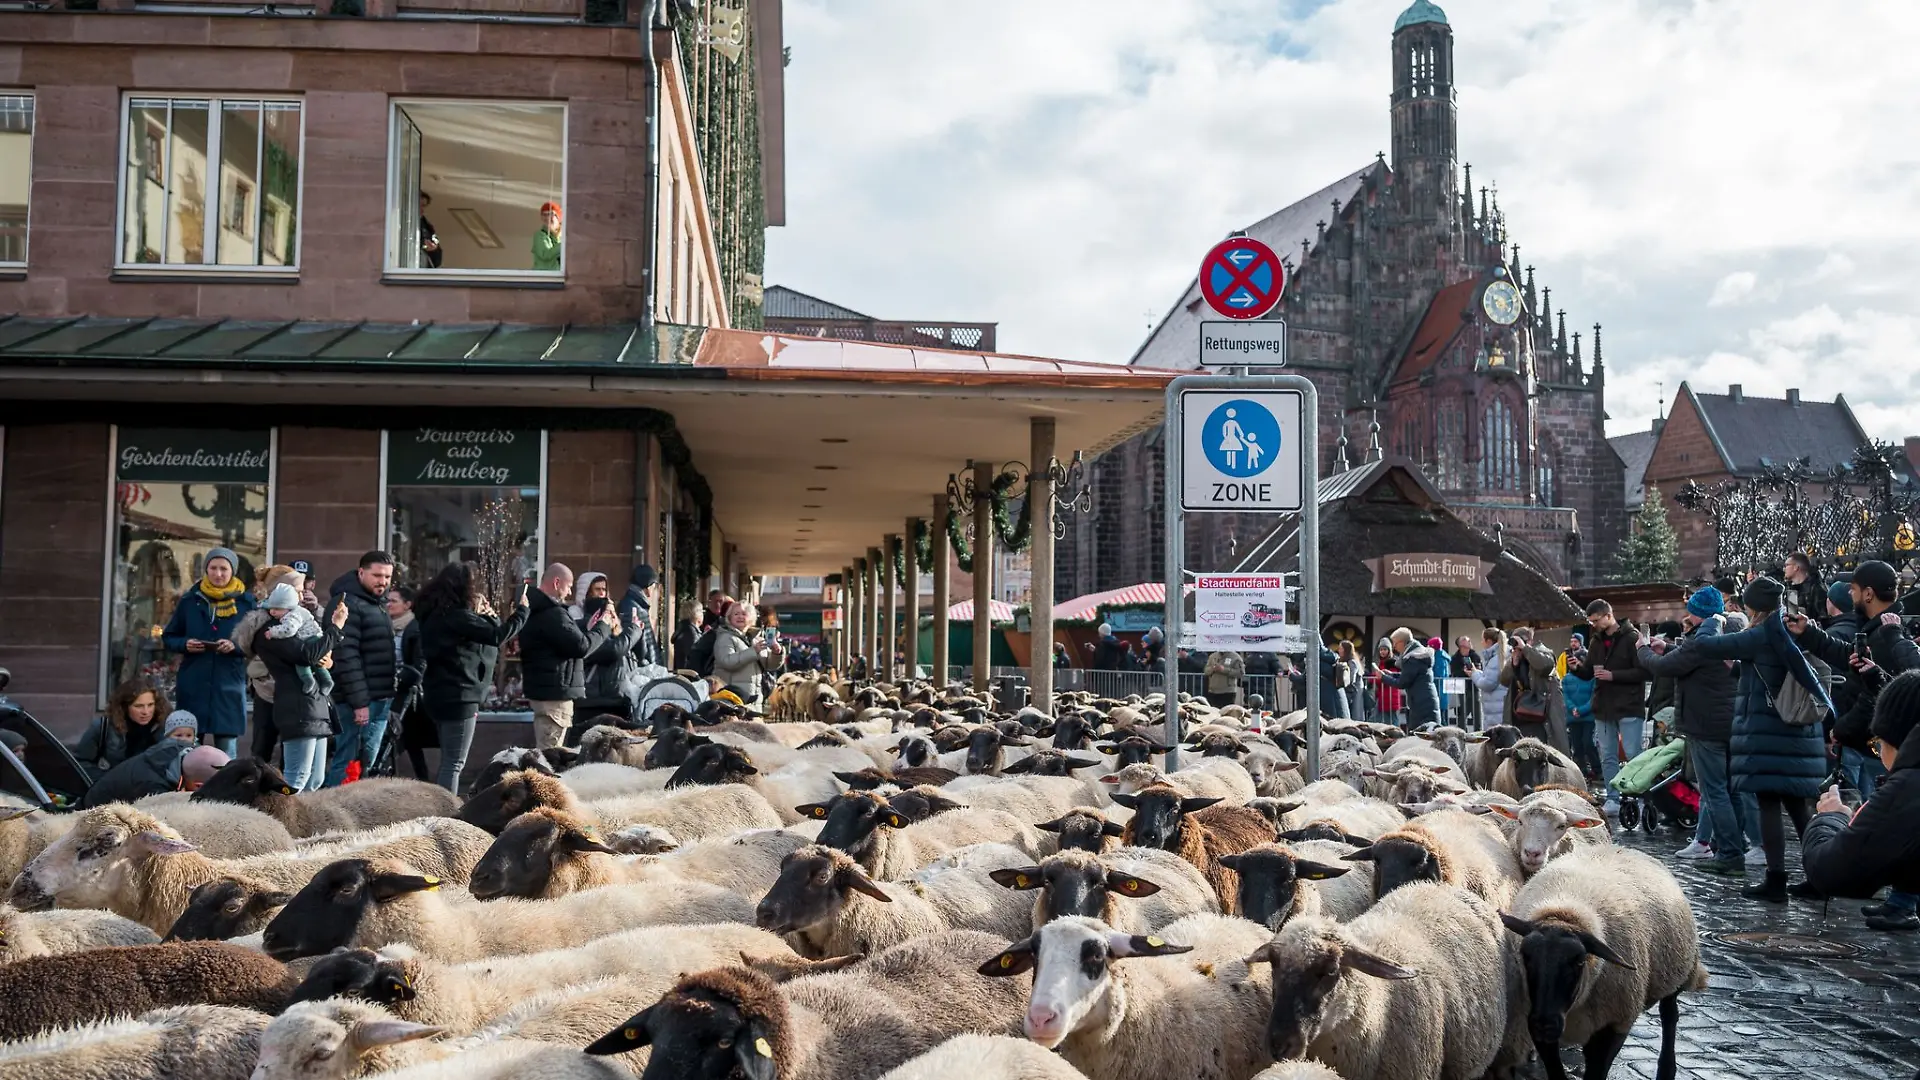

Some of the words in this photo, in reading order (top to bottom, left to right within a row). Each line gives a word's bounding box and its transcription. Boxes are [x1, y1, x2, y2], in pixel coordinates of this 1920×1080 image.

[1205, 336, 1280, 354] Rettungsweg
[416, 427, 515, 444] Souvenirs
[121, 446, 268, 469] Geschenkartikel
[447, 445, 482, 458] aus
[416, 458, 511, 484] Nürnberg
[1212, 483, 1271, 502] ZONE
[1390, 558, 1476, 580] Schmidt-Honig
[1201, 577, 1277, 588] Stadtrundfahrt
